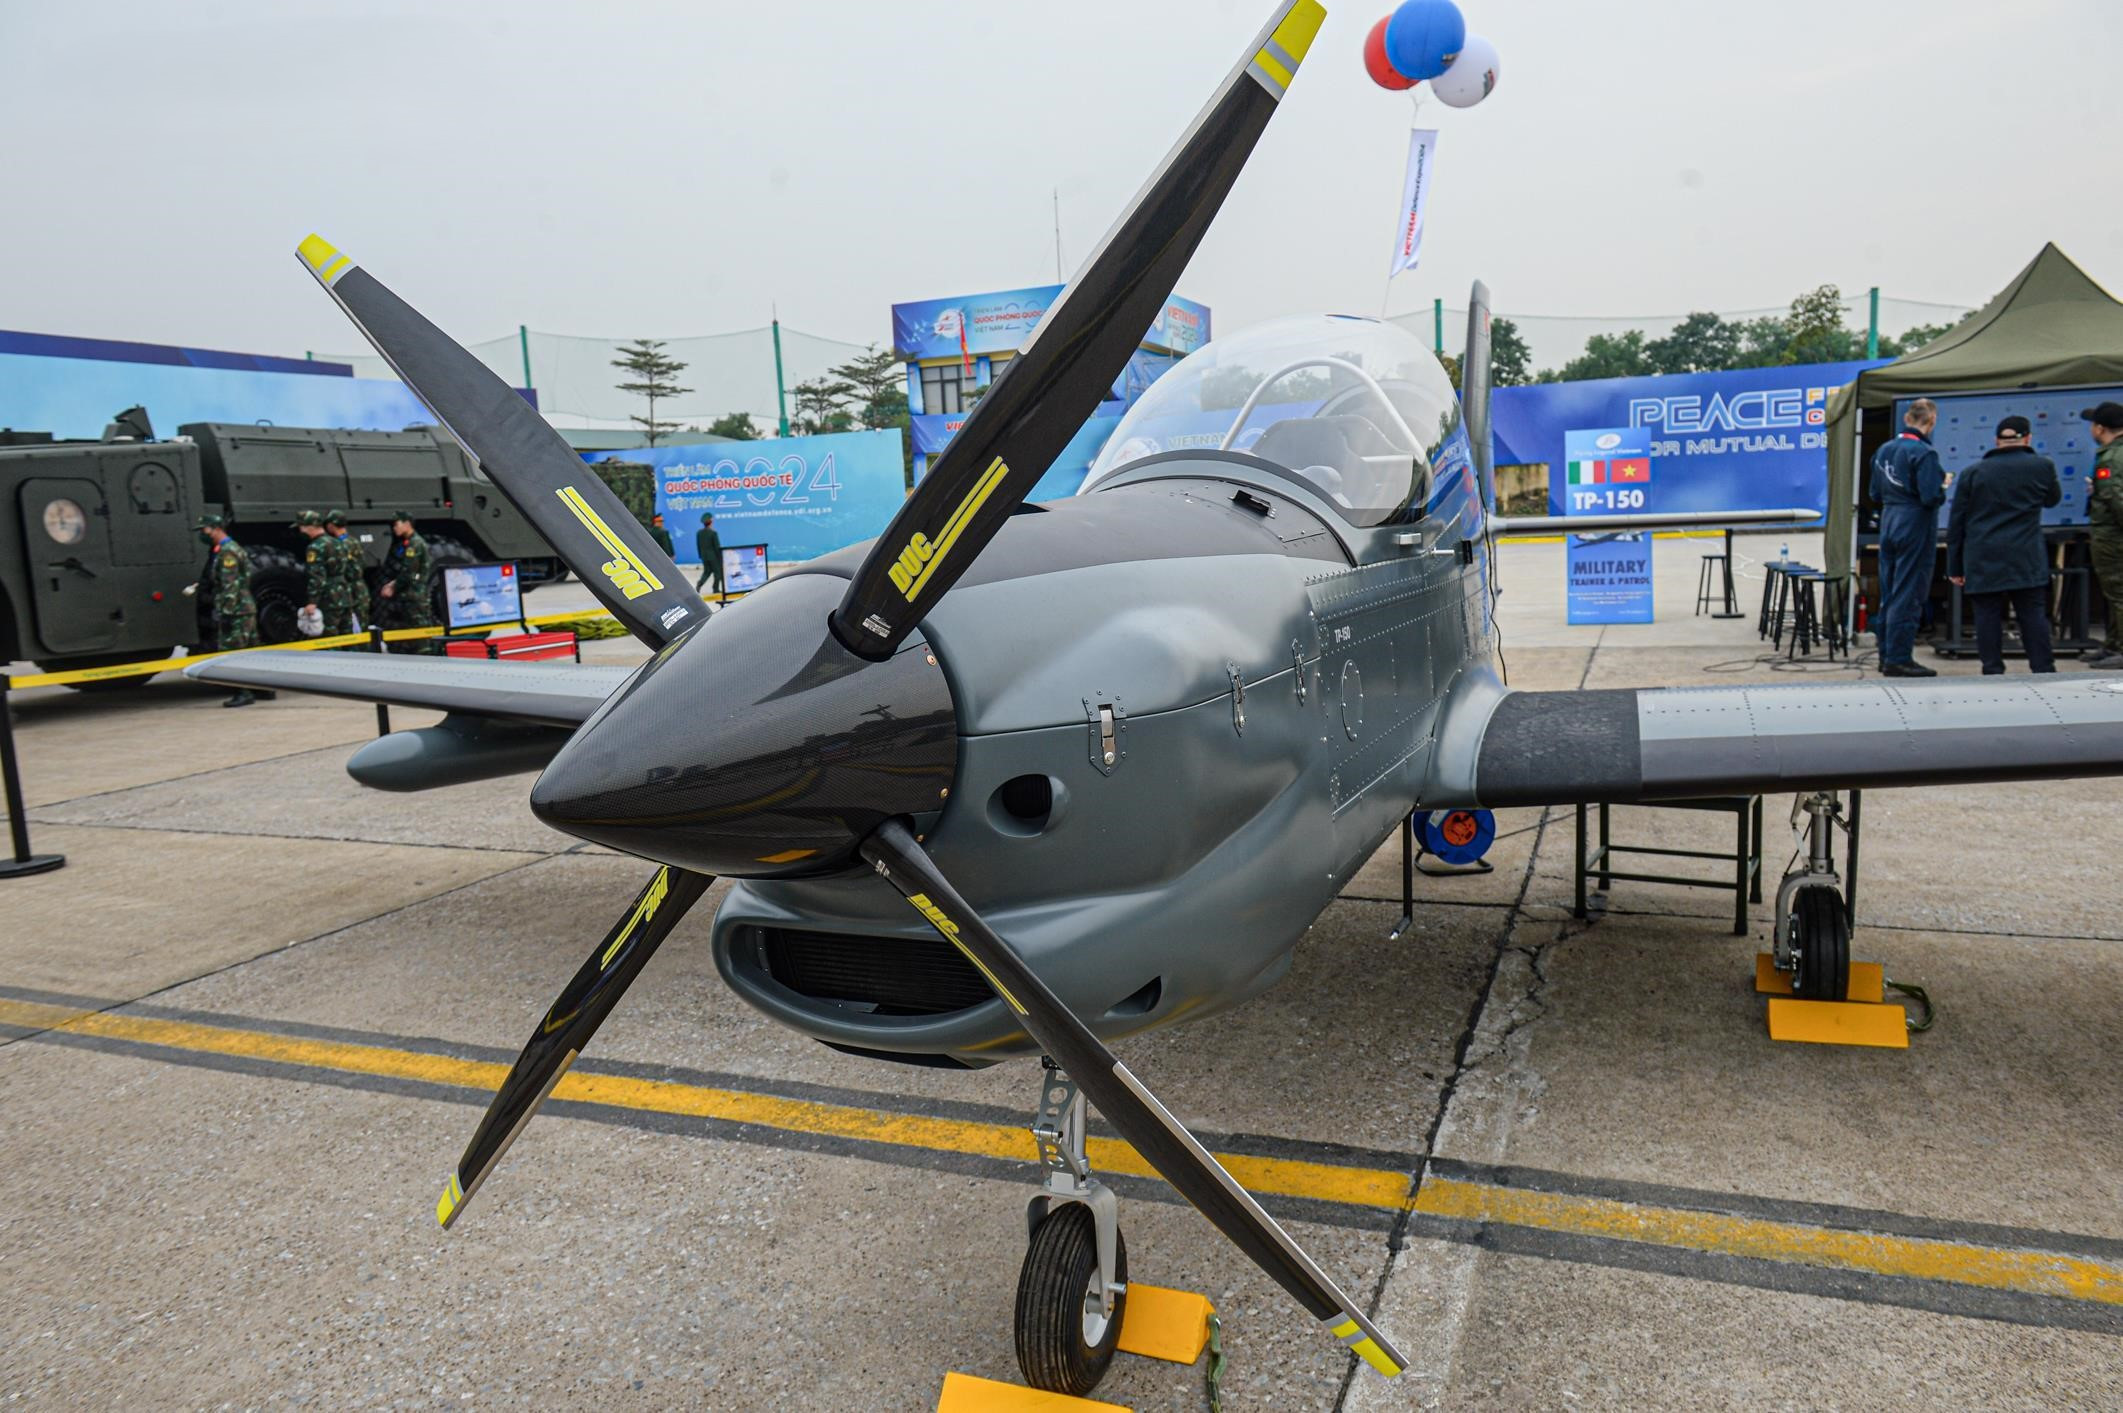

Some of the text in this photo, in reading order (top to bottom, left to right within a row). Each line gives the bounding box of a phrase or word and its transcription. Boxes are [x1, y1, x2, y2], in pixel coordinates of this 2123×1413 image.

[1630, 388, 1803, 434] PEACE
[1650, 440, 1681, 458] OR
[1685, 433, 1796, 455] MUTUAL
[1573, 489, 1645, 510] TP-150
[1573, 559, 1646, 575] MILITARY
